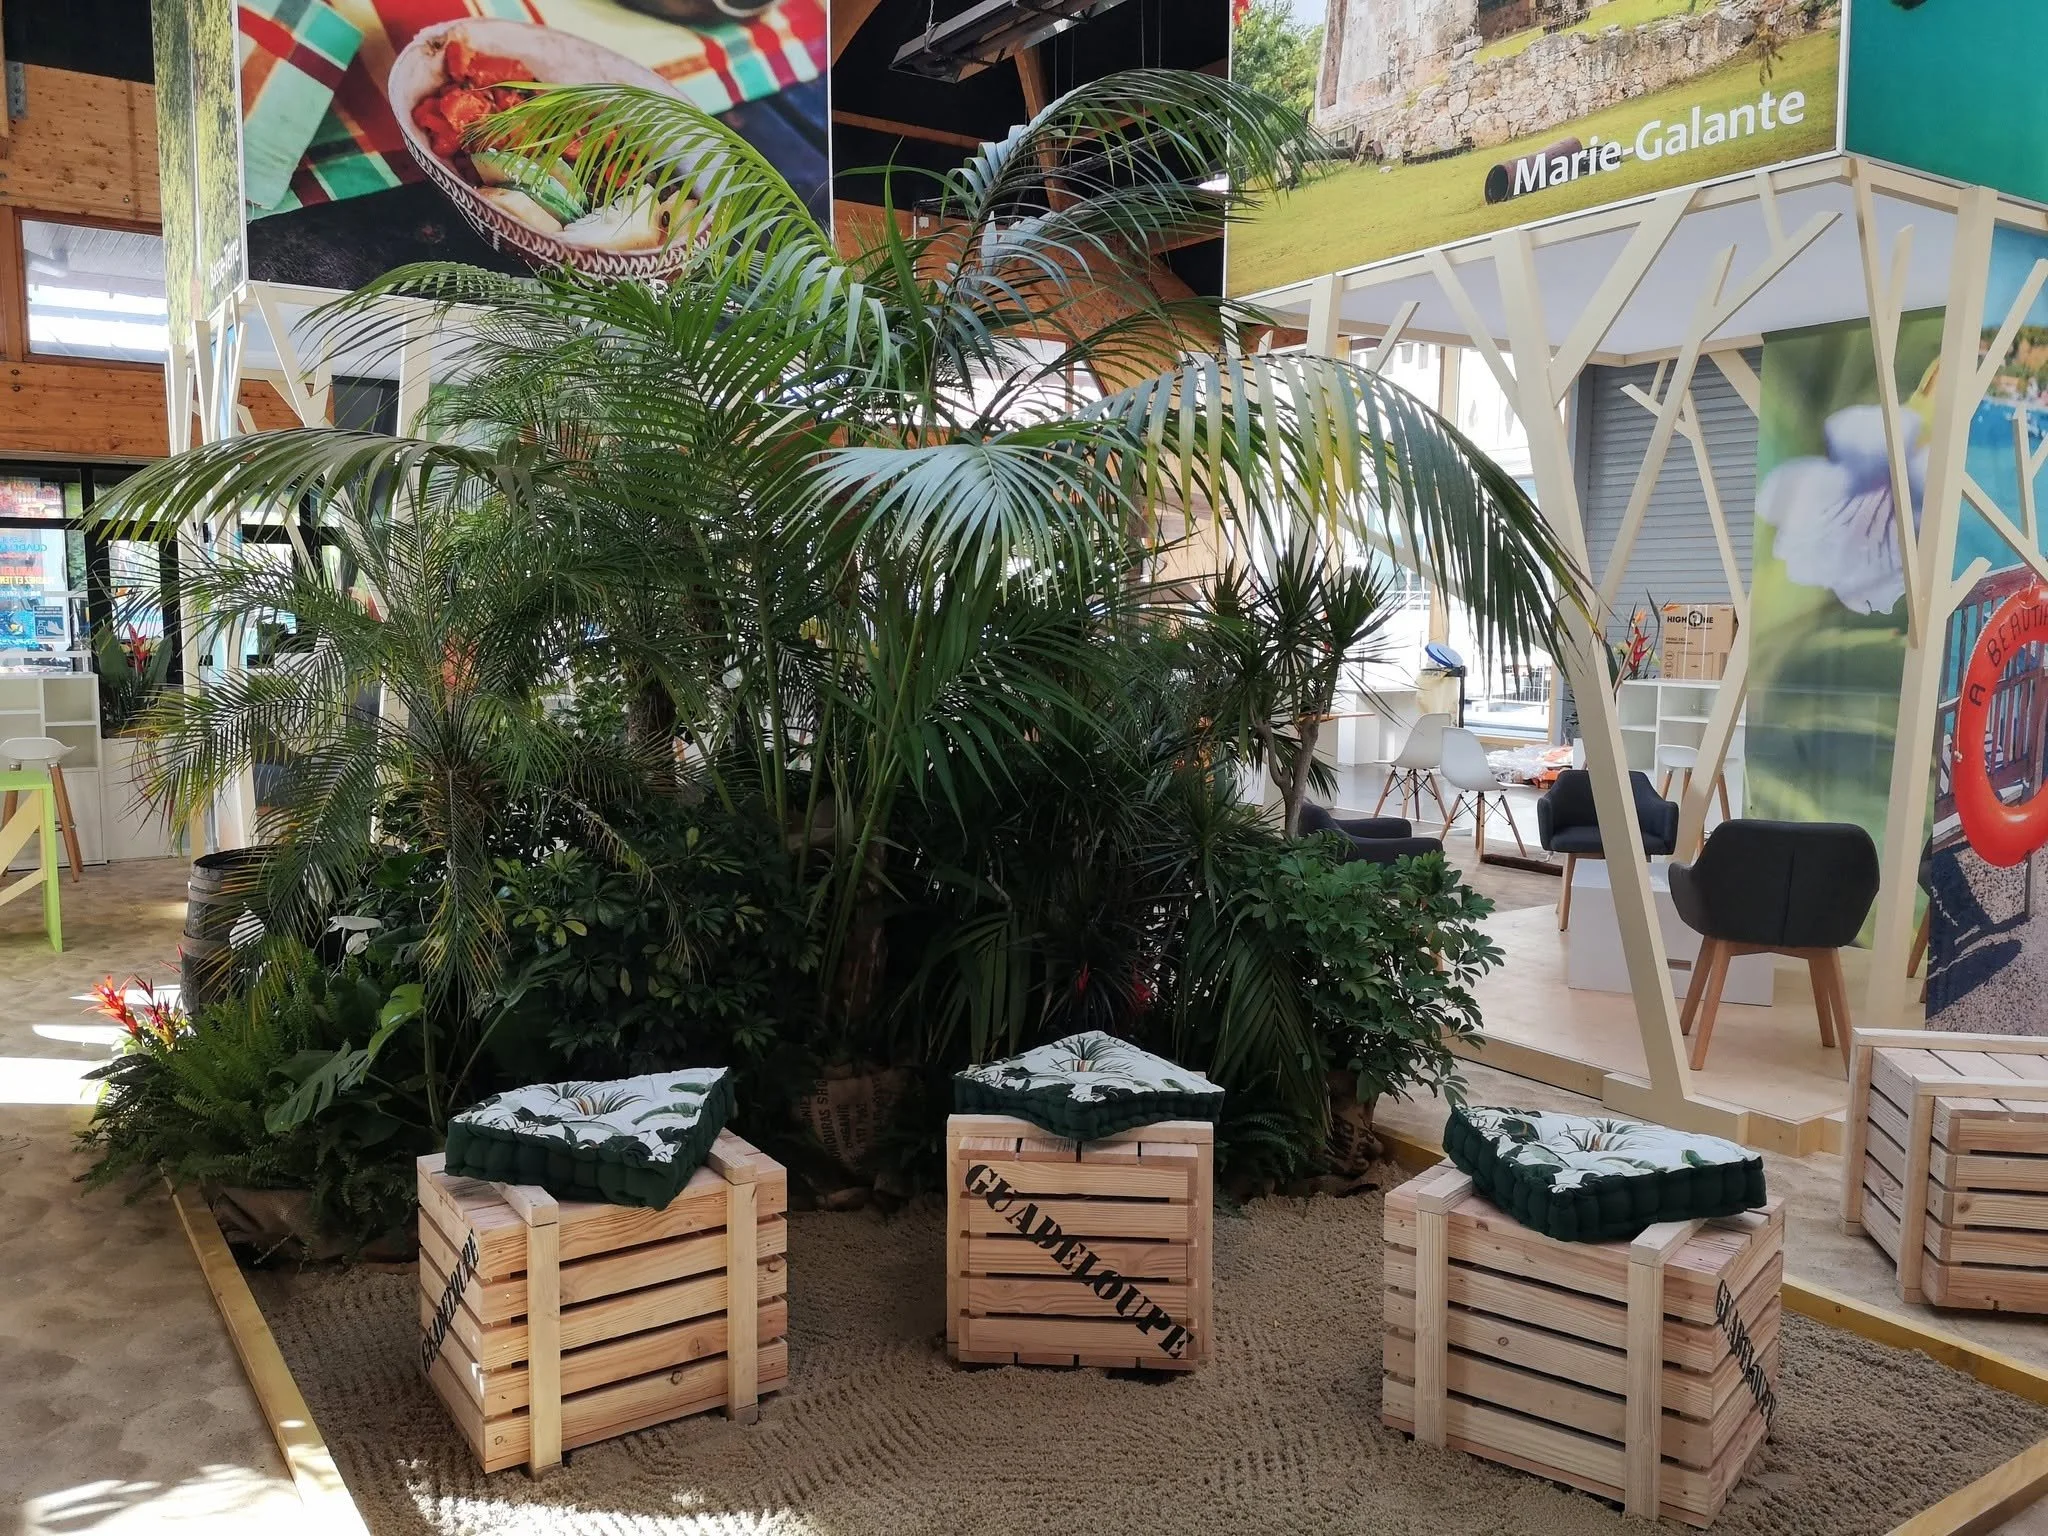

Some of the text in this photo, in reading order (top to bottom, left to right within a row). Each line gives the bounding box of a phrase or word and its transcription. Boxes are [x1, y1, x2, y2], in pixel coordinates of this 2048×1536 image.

[1512, 89, 1806, 197] Marie-Galante
[209, 238, 240, 290] Basse-Terre
[1969, 683, 1986, 707] A
[965, 1164, 1195, 1359] GUADELOUPE
[1715, 1278, 1777, 1433] GUADELOUPE
